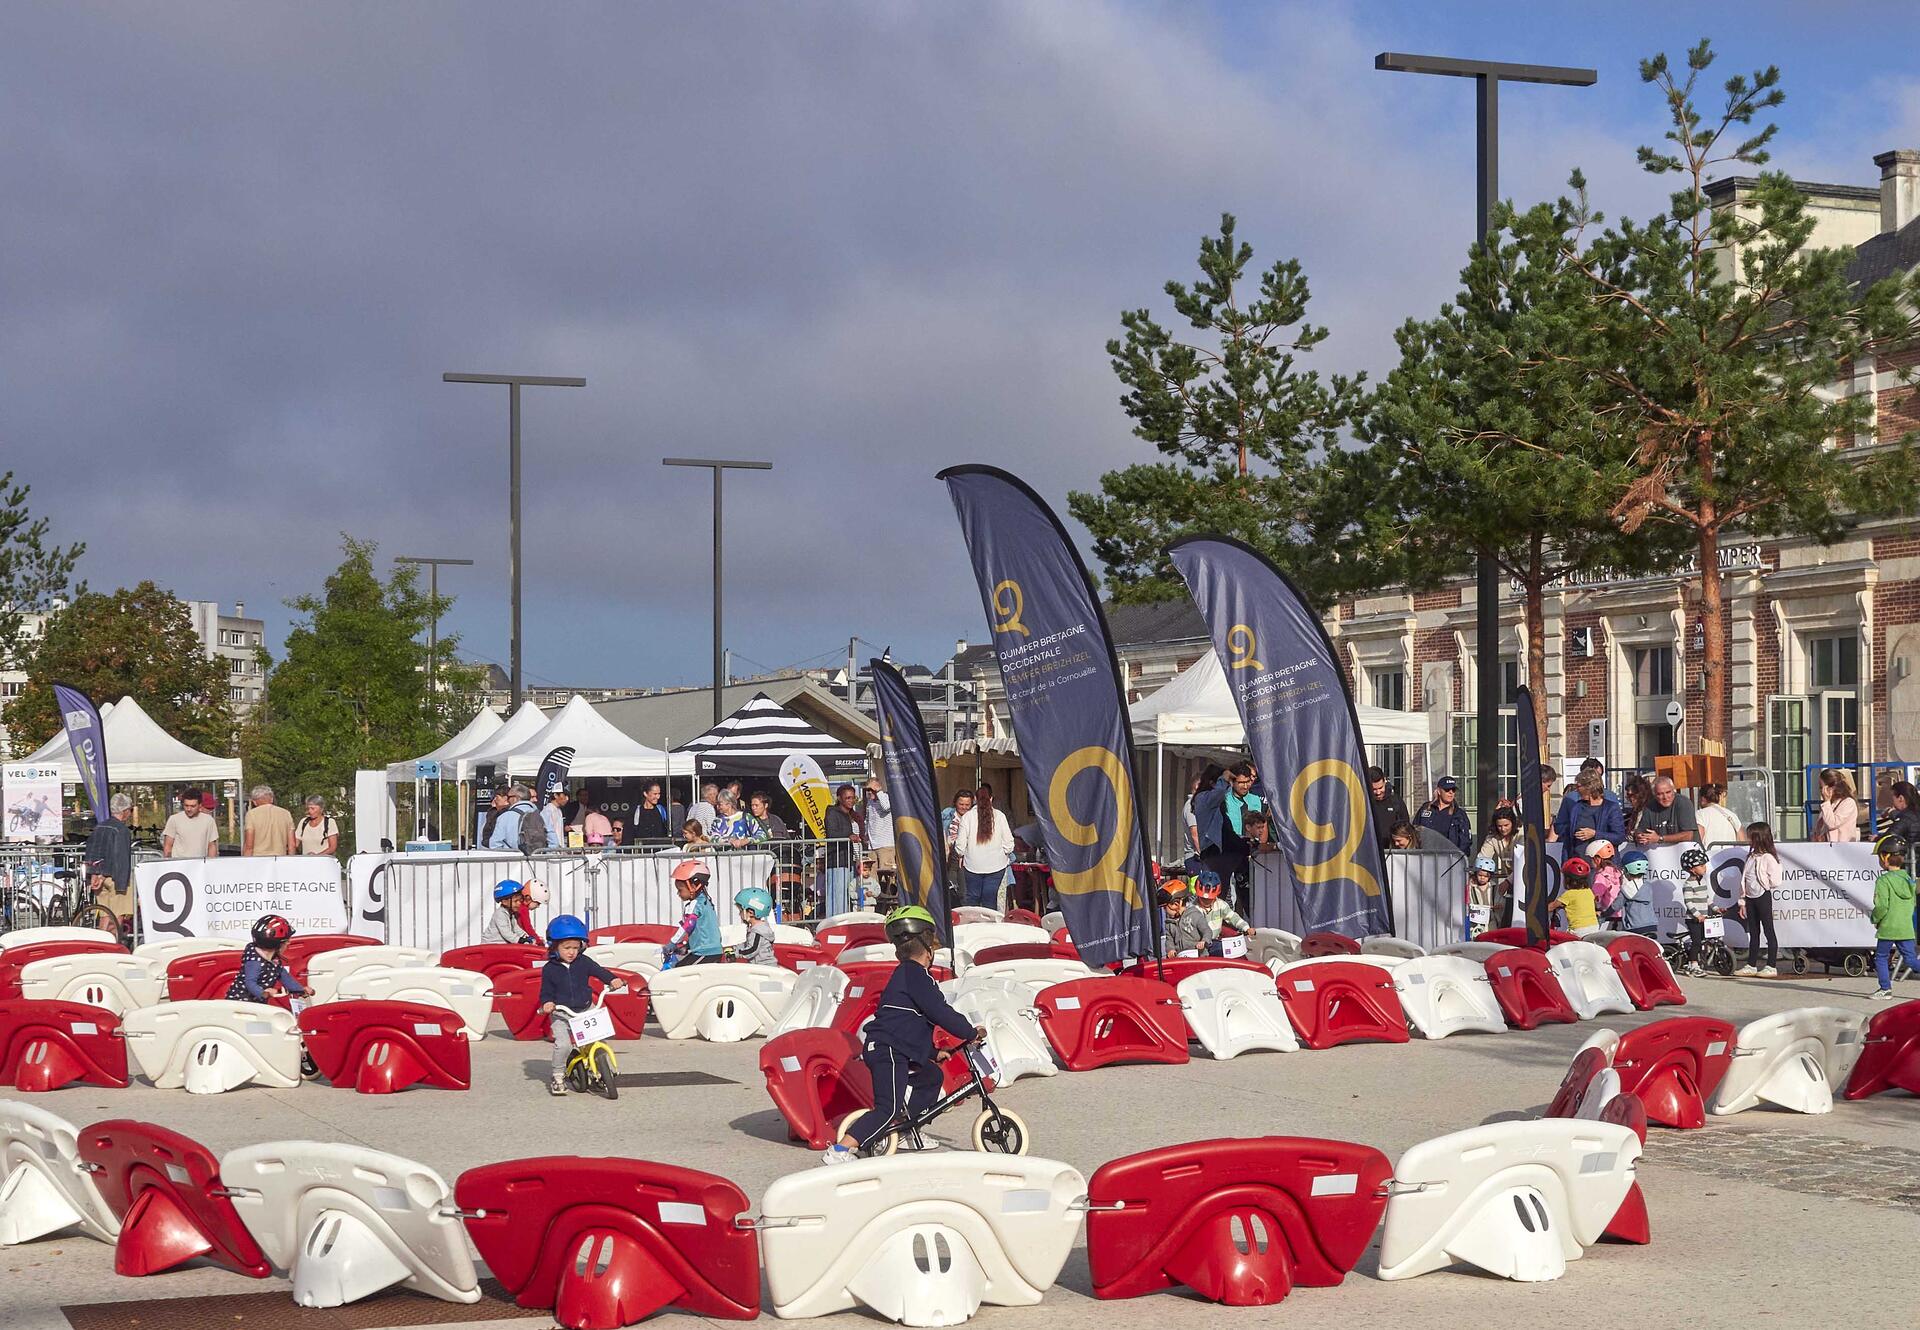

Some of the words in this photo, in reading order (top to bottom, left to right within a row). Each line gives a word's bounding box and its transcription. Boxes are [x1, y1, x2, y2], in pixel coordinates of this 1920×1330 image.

[1000, 641, 1039, 660] QUIMPER
[1040, 624, 1086, 647] BRETAGNE
[1002, 646, 1062, 673] OCCIDENTALE
[1008, 667, 1040, 684] KEMPER
[1041, 658, 1072, 674] BREIZH
[1073, 651, 1092, 663] IZEL
[1238, 674, 1274, 692] QUIMPER
[1274, 658, 1318, 678] BRETAGNE
[1008, 692, 1018, 701] Le
[1038, 682, 1046, 691] de
[1056, 666, 1097, 684] Cornouaille
[1242, 678, 1296, 702] OCCIDENTALE
[1275, 708, 1282, 716] de
[1292, 693, 1330, 710] Cornouaille
[1643, 870, 1686, 880] ETAGNE
[1782, 870, 1820, 880] IMPER
[204, 882, 264, 895] QUIMPER
[267, 882, 336, 893] BRETAGNE
[1772, 888, 1850, 900] CCIDENTALE
[206, 900, 292, 912] OCCIDENTALE
[1663, 907, 1686, 918] IZEL
[1773, 908, 1816, 920] EMPER
[1820, 908, 1864, 920] BREIZH
[308, 918, 336, 928] IZEL
[584, 1017, 598, 1029] 93
